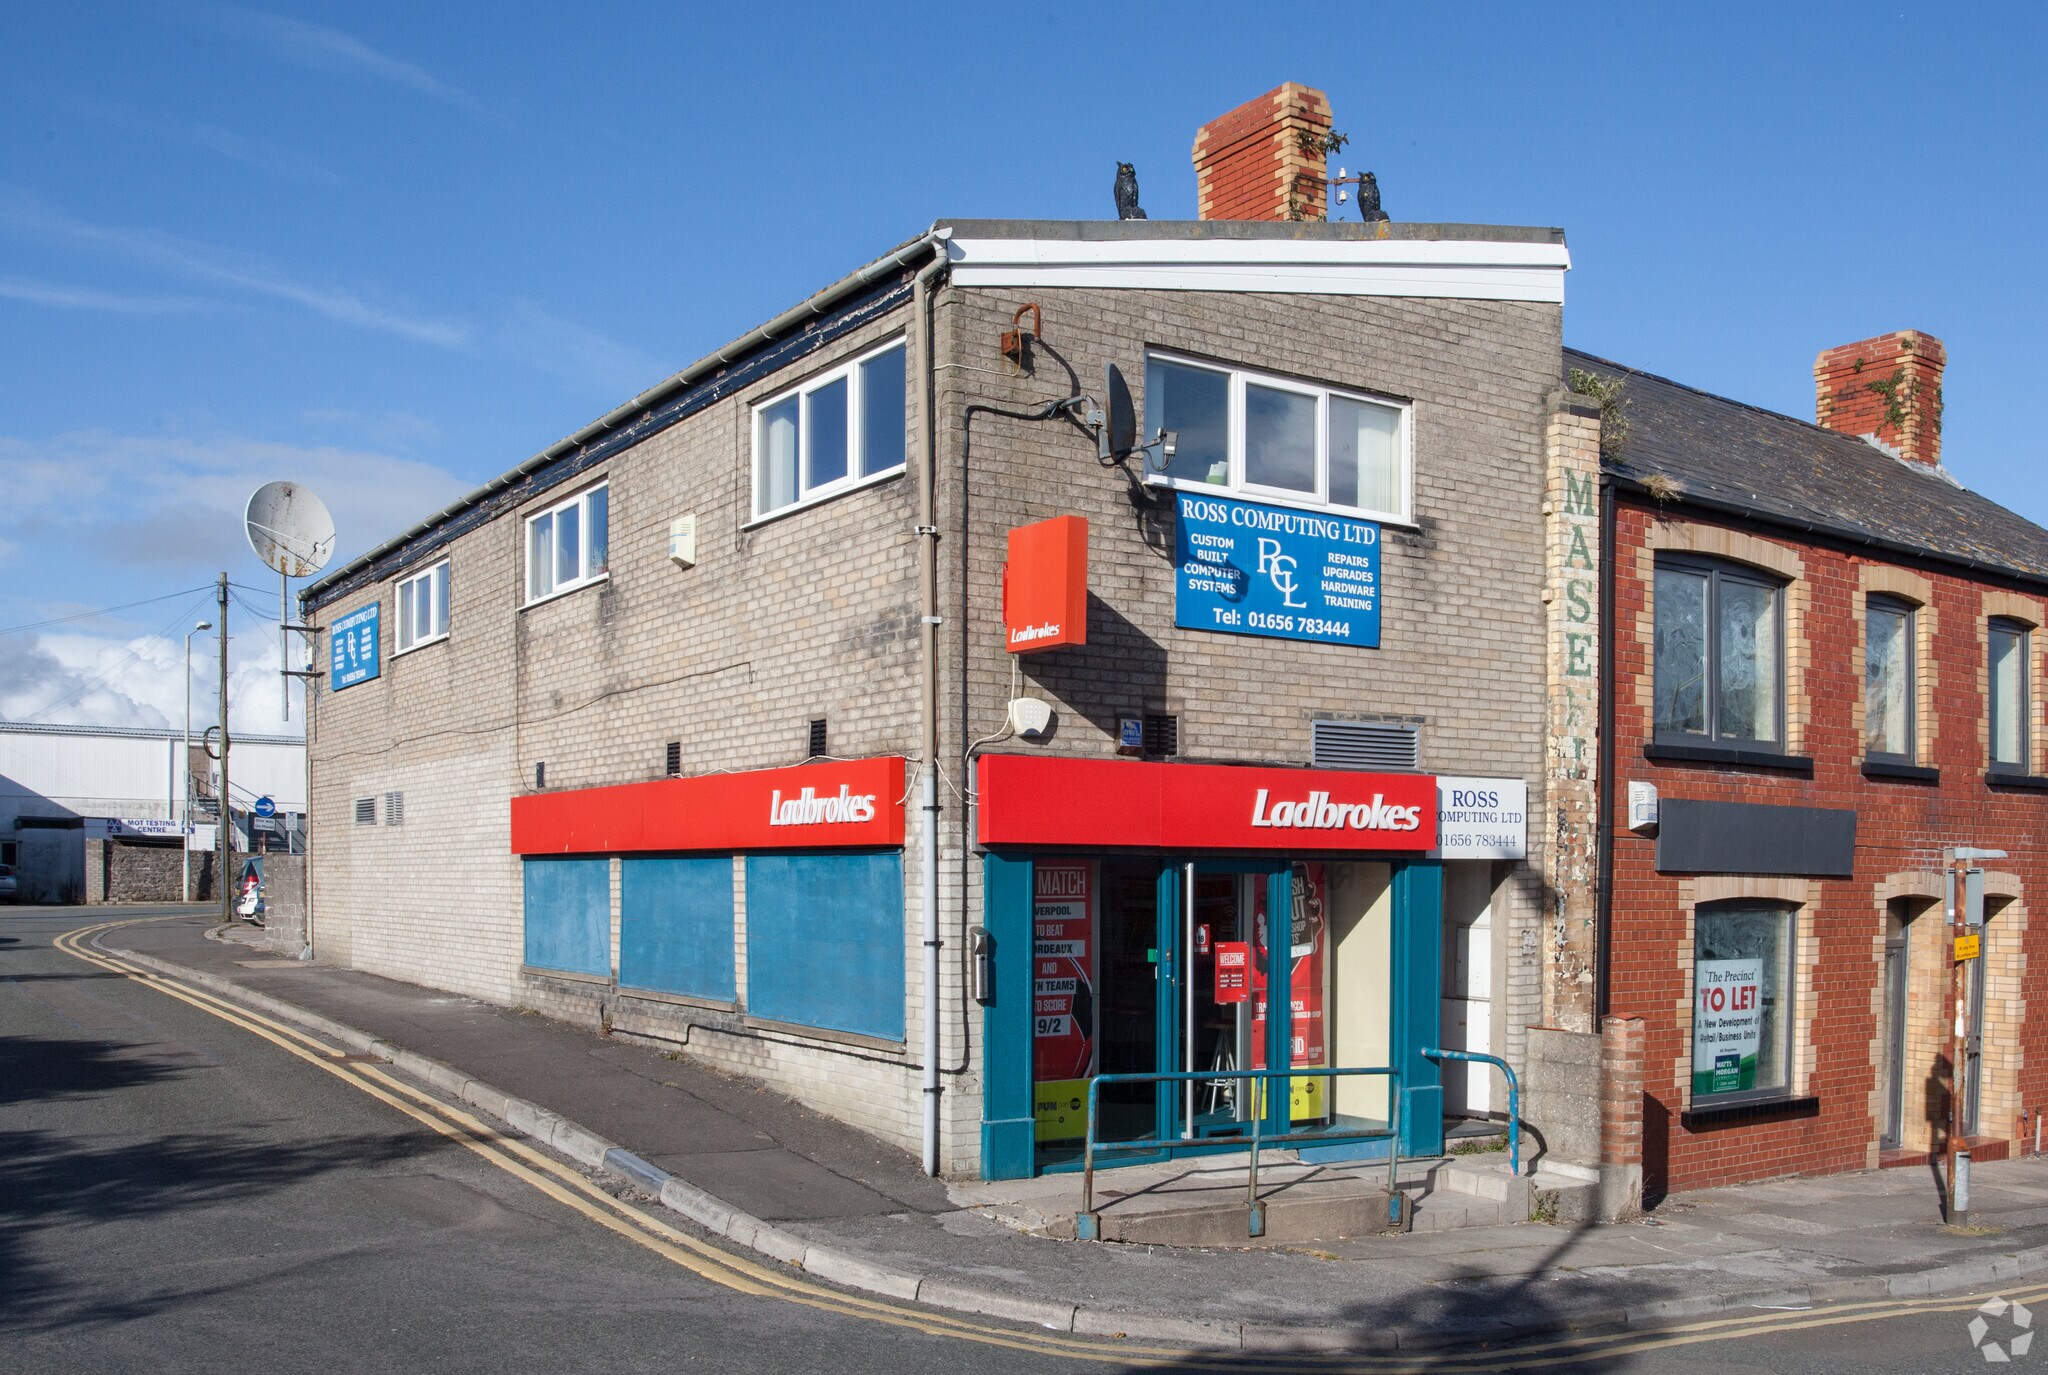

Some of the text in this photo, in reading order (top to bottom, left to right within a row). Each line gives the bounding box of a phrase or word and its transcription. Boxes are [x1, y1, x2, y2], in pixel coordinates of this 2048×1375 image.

[1182, 499, 1376, 545] ROSS COMPUTING LTD
[1191, 533, 1234, 549] CUSTOM
[1197, 549, 1228, 563] BUILT
[1328, 553, 1369, 568] REPAIRS
[1184, 563, 1241, 580] COMPUTER
[1323, 567, 1373, 582] UPGRADES
[1189, 579, 1236, 594] SYSTEMS
[1321, 580, 1375, 597] HARDWARE
[1324, 595, 1372, 611] TRAINING
[1213, 608, 1350, 637] Tel: 01656 783444
[1011, 623, 1059, 644] Ladbrokes
[770, 784, 876, 826] Ladbrokes
[1452, 790, 1498, 808] ROSS
[1252, 789, 1421, 830] Ladbrokes
[128, 819, 143, 827] MOT
[1501, 812, 1522, 823] LTD
[1436, 834, 1516, 846] 01656 783444
[1038, 871, 1086, 894] MATCH
[1036, 924, 1064, 936] TO BEAT
[1220, 954, 1244, 964] WELCOME
[1042, 962, 1057, 974] AND
[1046, 980, 1075, 991] TEAMS
[1044, 999, 1067, 1012] SCORE
[1701, 986, 1756, 1012] TO LET
[1038, 1019, 1061, 1034] 9/2
[1698, 1020, 1702, 1029] A
[1705, 1019, 1717, 1028] New
[1719, 1017, 1752, 1028] Development
[1744, 1030, 1756, 1040] Units
[1038, 1101, 1057, 1111] FUN
